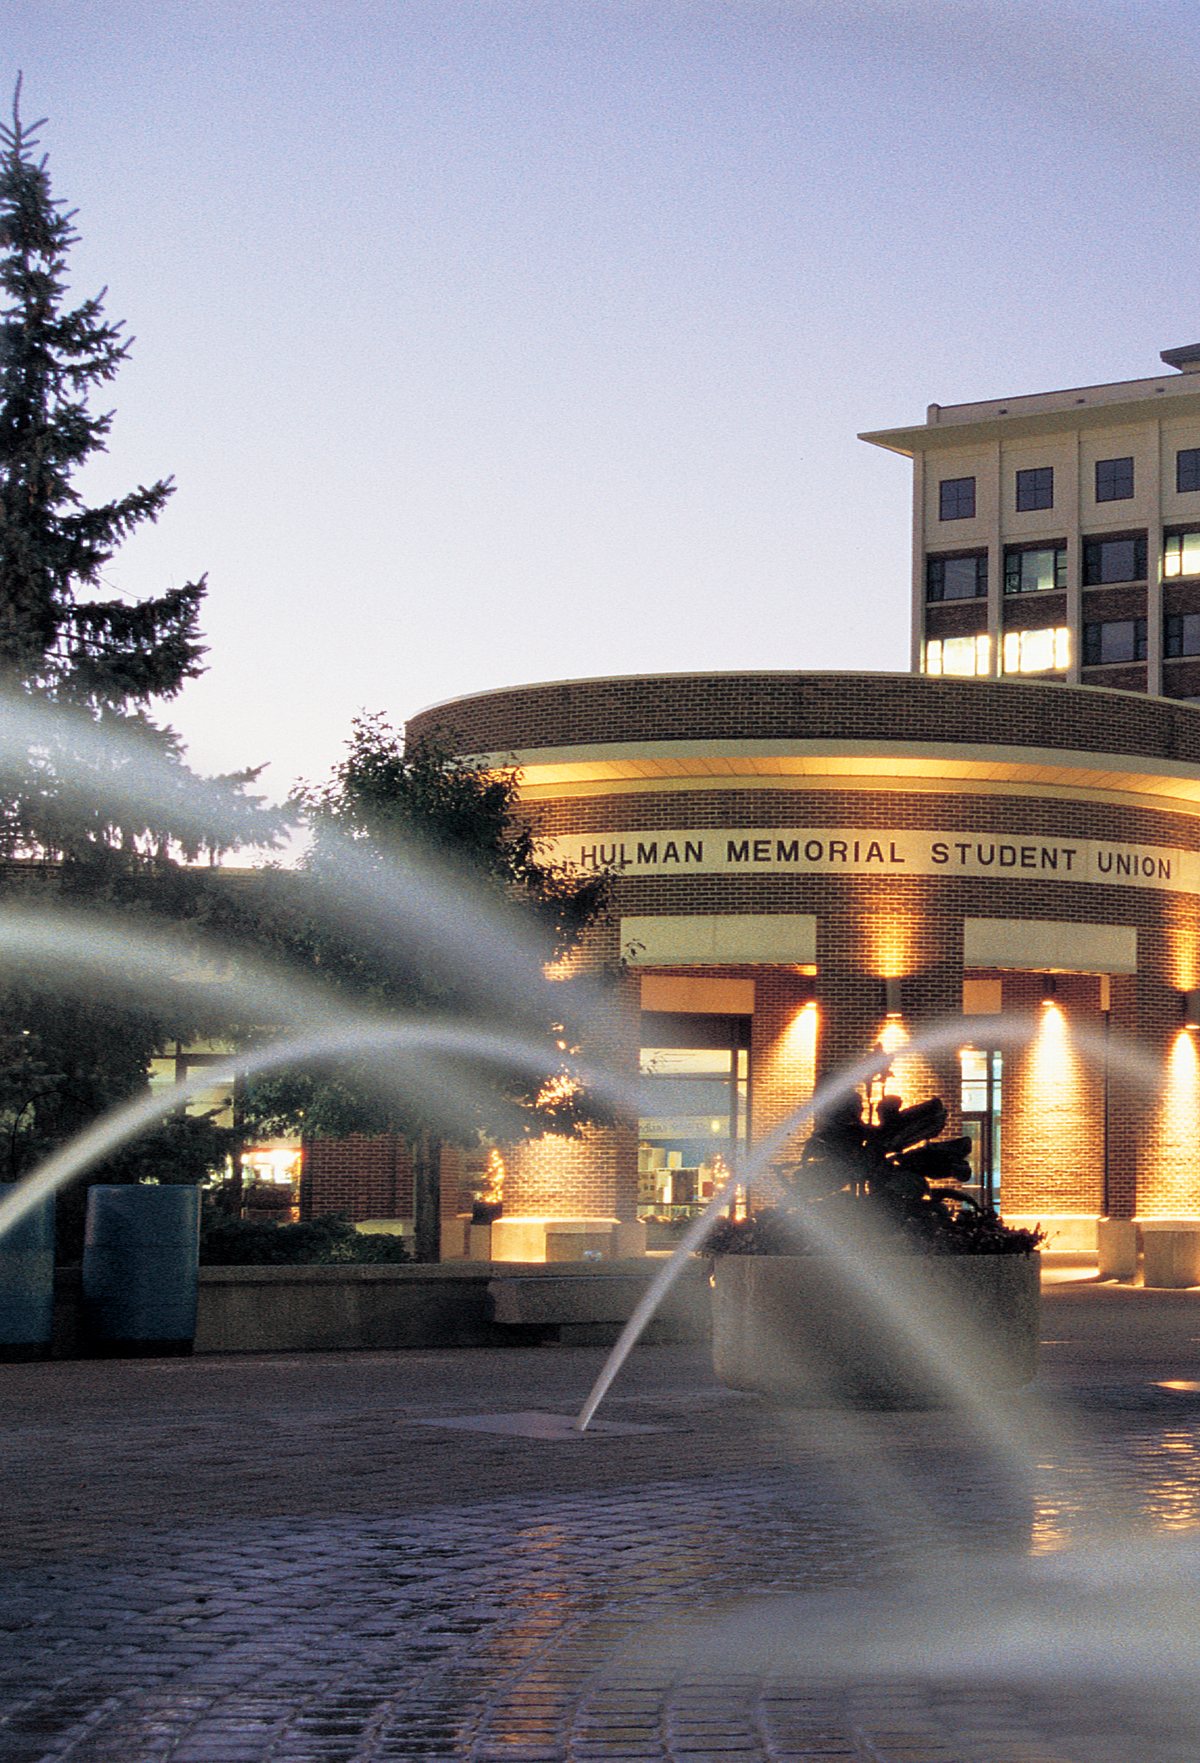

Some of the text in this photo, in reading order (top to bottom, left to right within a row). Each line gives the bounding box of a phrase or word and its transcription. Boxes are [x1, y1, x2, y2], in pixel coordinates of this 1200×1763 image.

[581, 840, 1171, 880] HULMAN MEMORIAL STUDENT UNION
